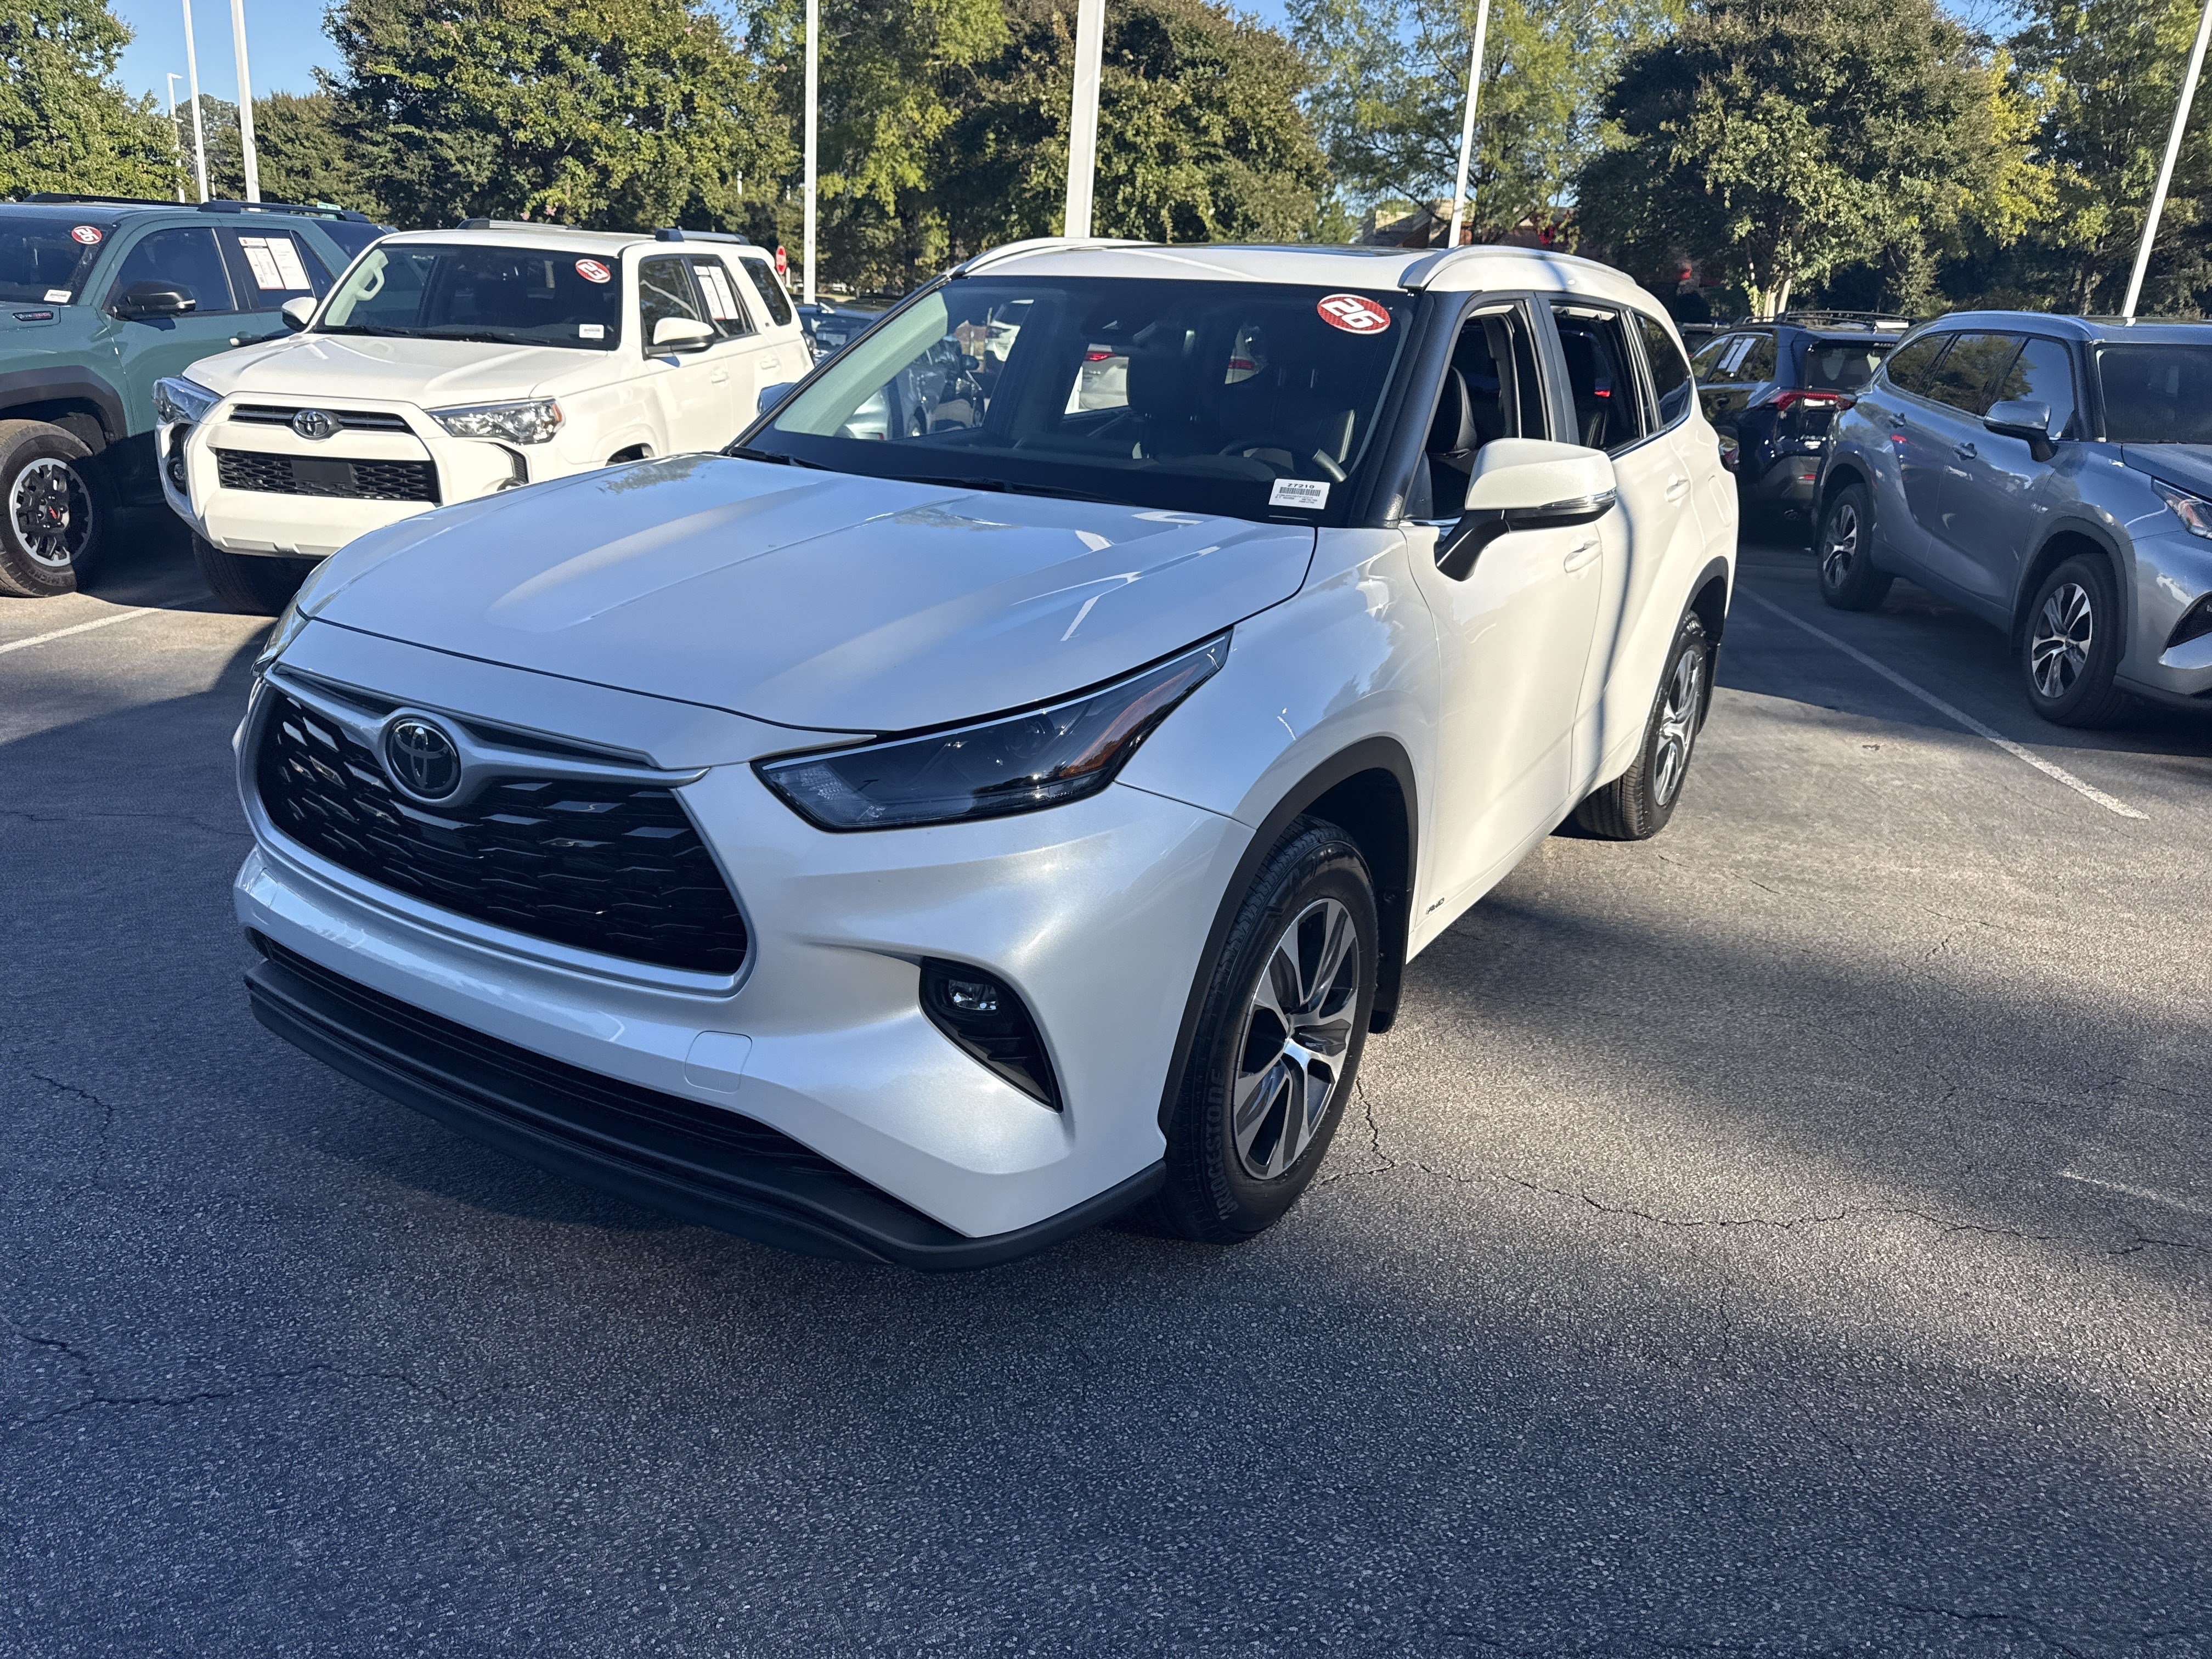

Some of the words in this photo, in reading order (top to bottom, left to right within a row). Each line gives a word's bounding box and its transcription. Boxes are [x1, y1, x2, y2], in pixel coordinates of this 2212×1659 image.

[74, 228, 99, 241] 26
[577, 262, 608, 280] 23
[1321, 298, 1386, 329] 26
